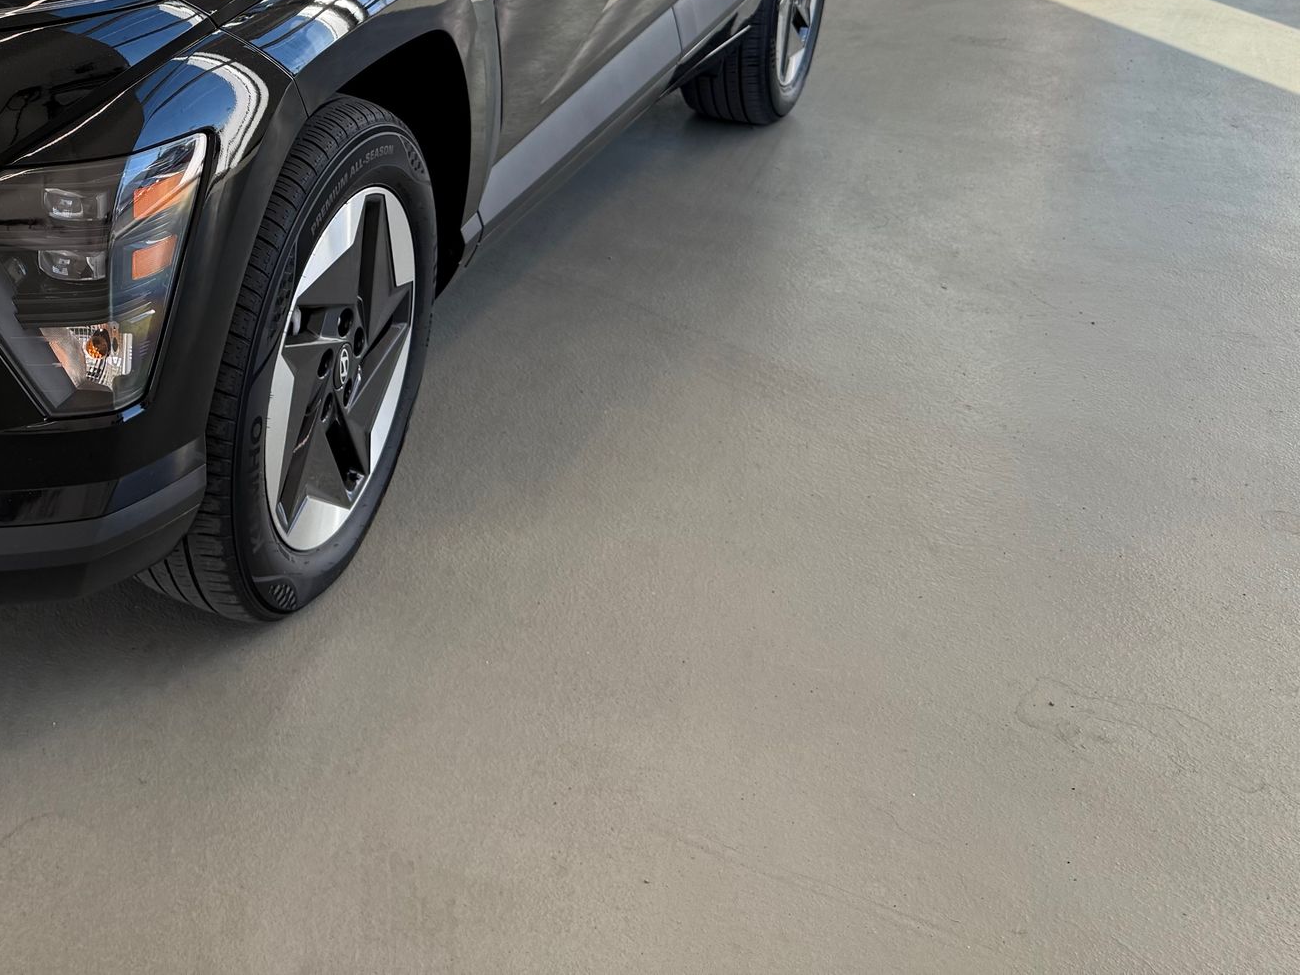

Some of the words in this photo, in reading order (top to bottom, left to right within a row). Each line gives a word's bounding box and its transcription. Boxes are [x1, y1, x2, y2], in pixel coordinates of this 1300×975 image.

[310, 172, 349, 235] PREMIUM
[349, 145, 394, 178] ALL-SEASON
[248, 416, 264, 554] KMHO
